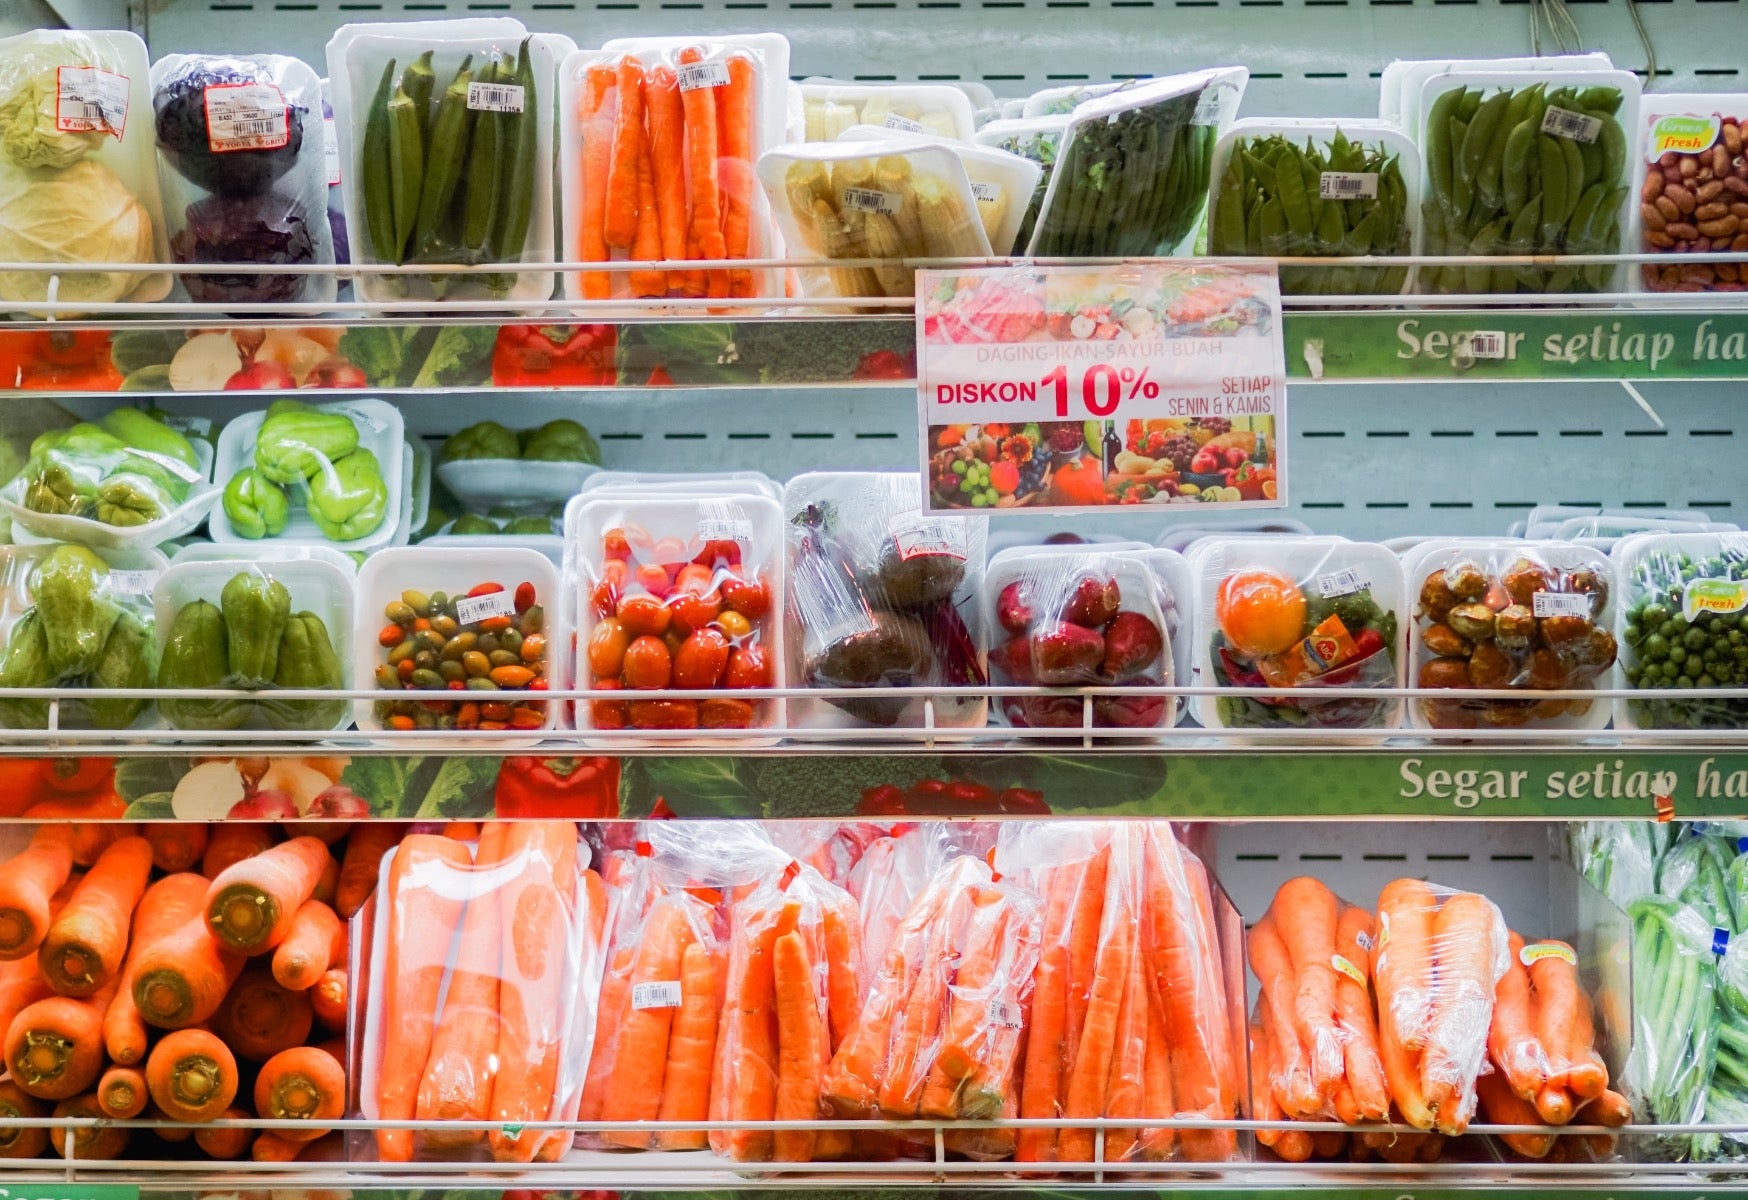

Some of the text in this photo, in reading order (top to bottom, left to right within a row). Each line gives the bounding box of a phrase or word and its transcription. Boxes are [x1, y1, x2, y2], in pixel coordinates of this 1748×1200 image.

[1660, 120, 1704, 133] Green
[1663, 136, 1702, 149] fresh
[1397, 319, 1525, 369] Segr
[1543, 322, 1675, 371] setiap
[937, 364, 1160, 417] DISKON 10%
[1222, 376, 1271, 394] SETIAP
[1168, 395, 1271, 416] SENIN & KAMIS
[1699, 597, 1735, 609] fresh
[1317, 643, 1334, 660] ABC
[1400, 758, 1528, 809] Segar
